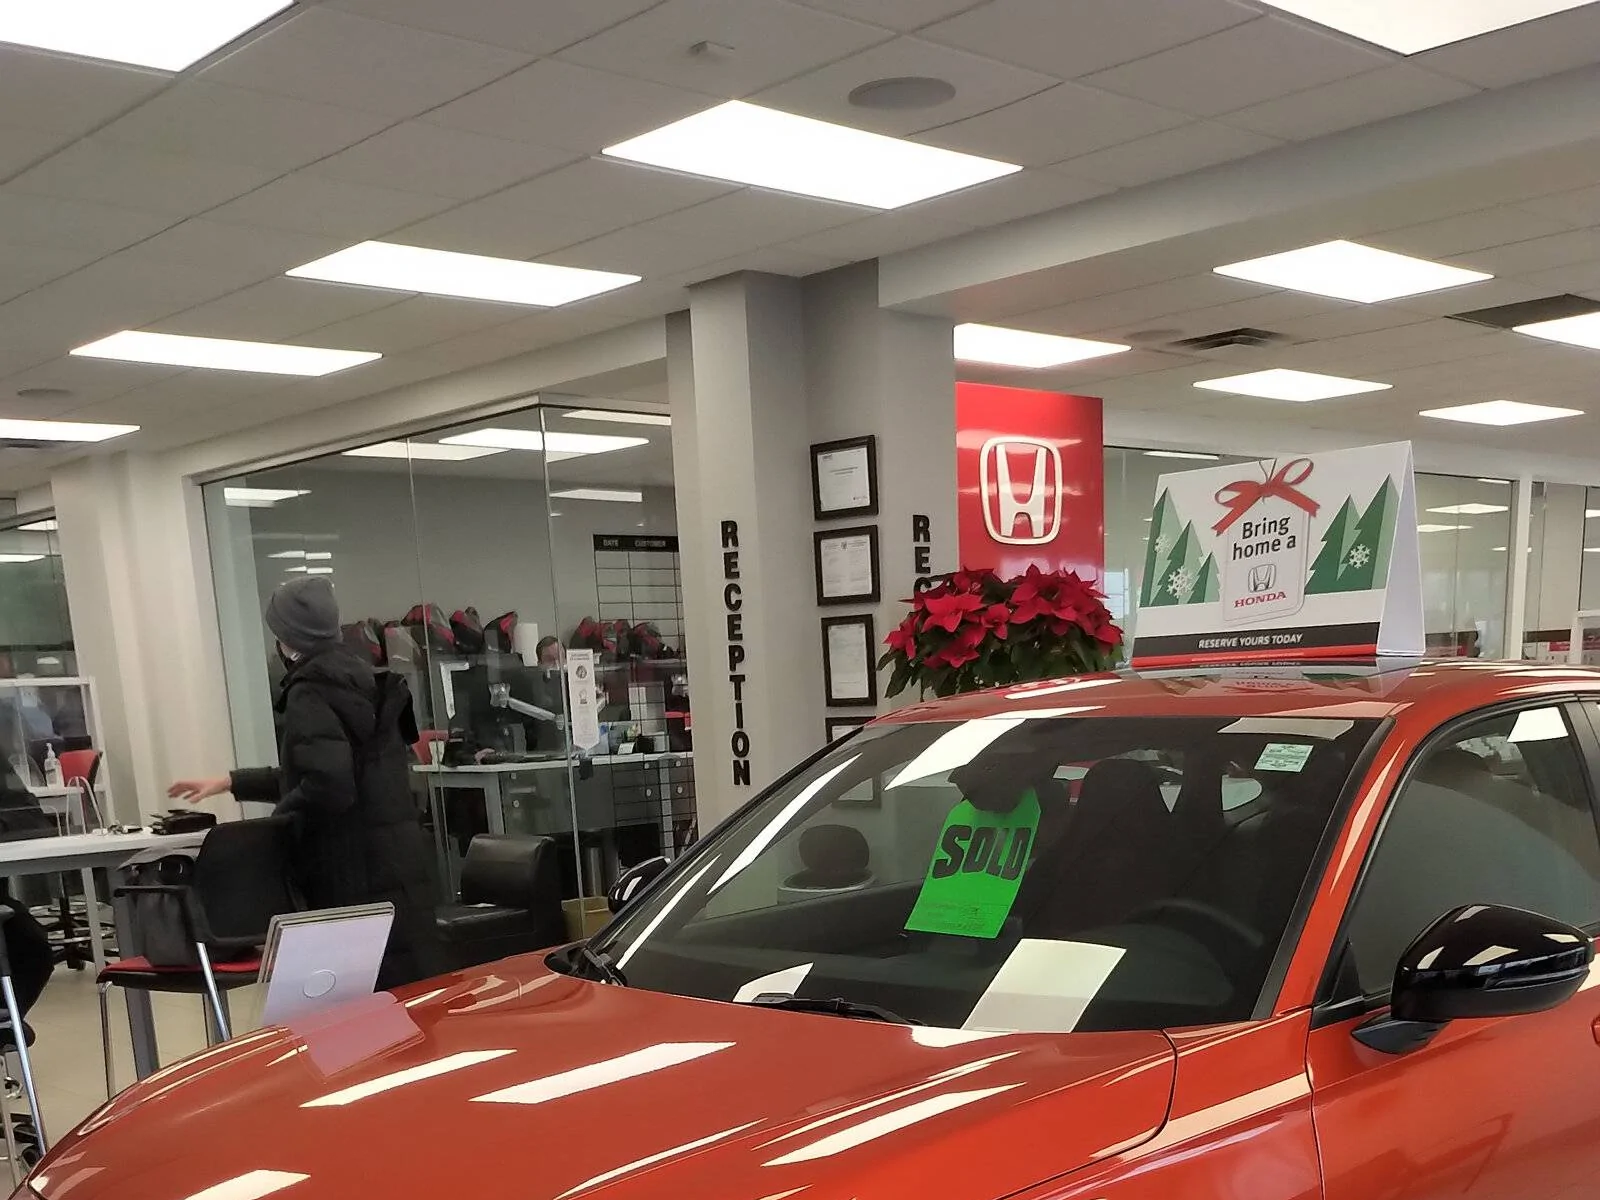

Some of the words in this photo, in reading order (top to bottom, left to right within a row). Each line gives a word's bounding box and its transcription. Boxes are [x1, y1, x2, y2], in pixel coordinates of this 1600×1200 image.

[1242, 517, 1291, 539] Bring
[1233, 539, 1281, 560] home
[1286, 535, 1297, 549] a
[1234, 591, 1287, 608] HONDA
[1198, 637, 1238, 649] RESERVE
[1239, 635, 1270, 646] YOURS
[1271, 633, 1303, 644] TODAY
[720, 520, 751, 786] RECEPTION
[932, 824, 1032, 881] SOLD
